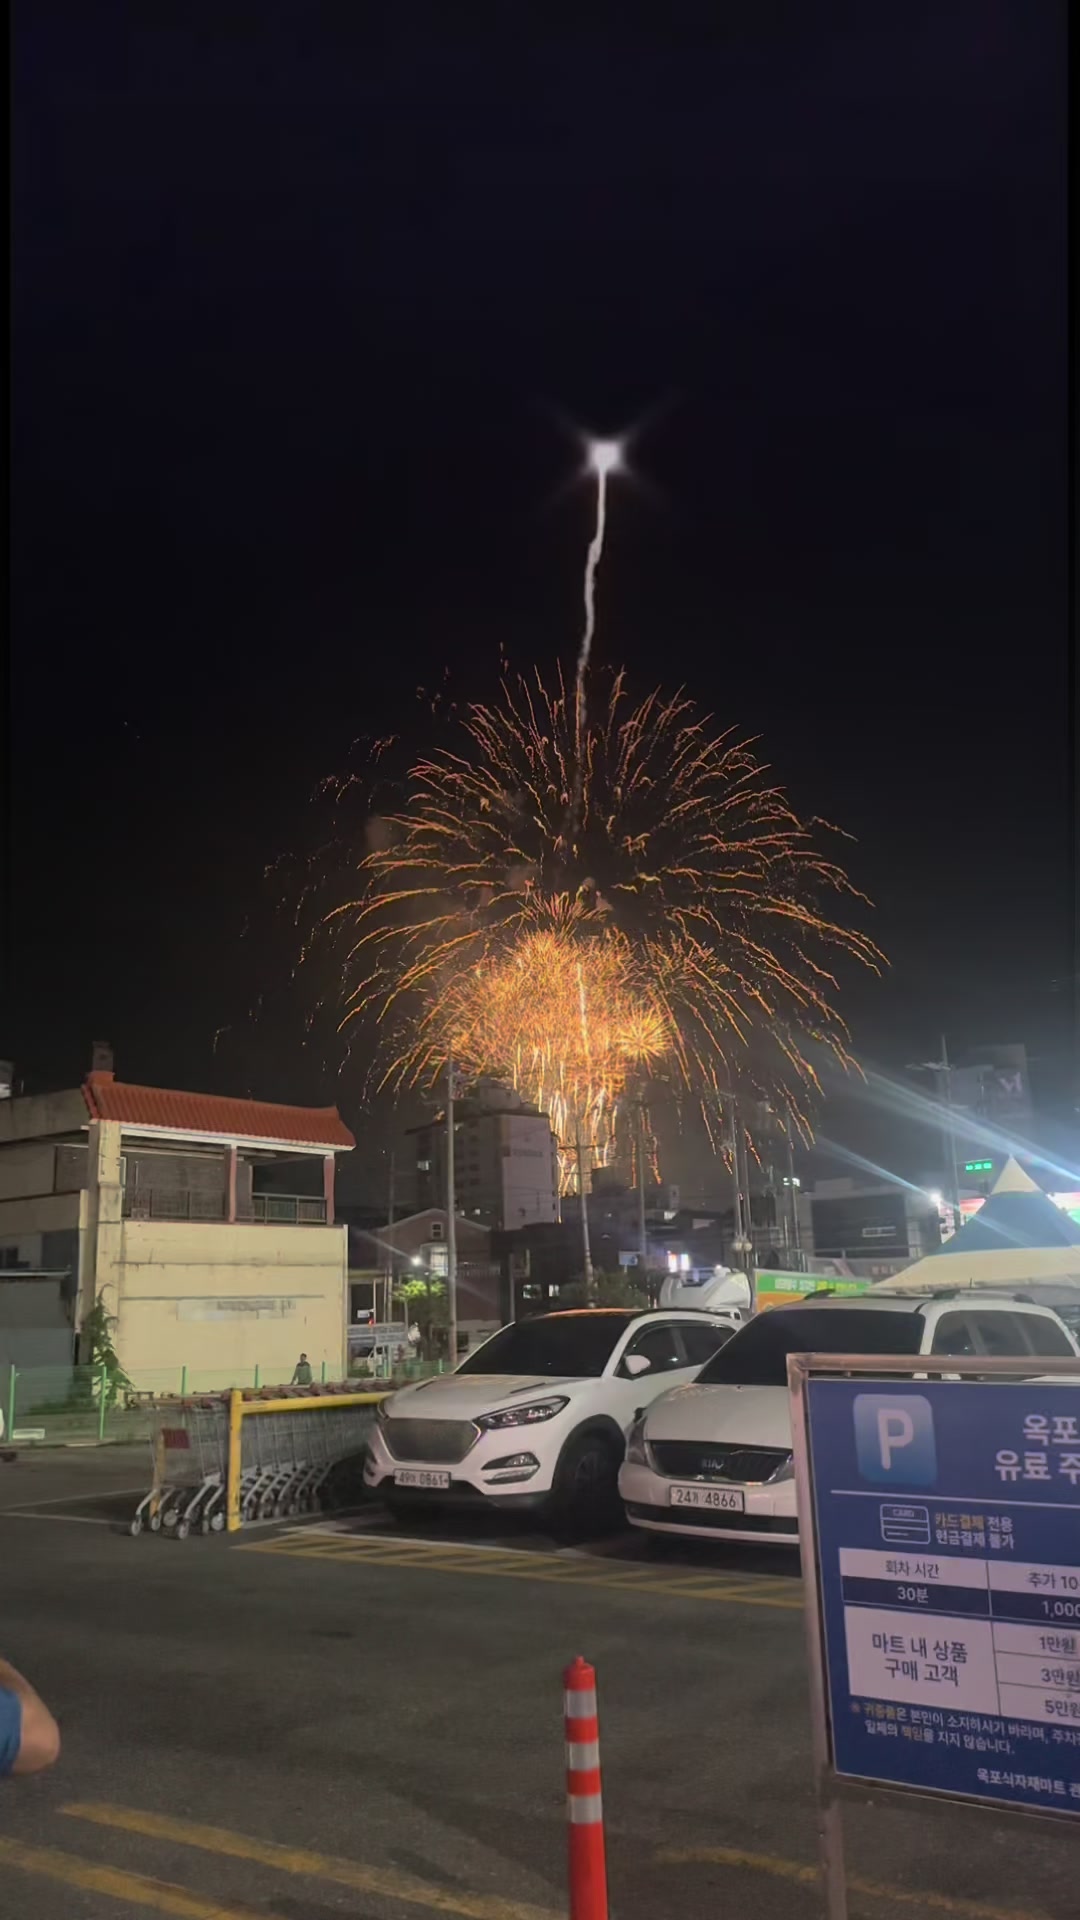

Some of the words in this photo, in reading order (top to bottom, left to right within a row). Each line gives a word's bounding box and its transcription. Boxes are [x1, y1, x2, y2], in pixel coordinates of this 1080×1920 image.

[878, 1408, 914, 1471] P
[1023, 1413, 1080, 1447] 옥포
[994, 1449, 1052, 1482] 유료
[704, 1491, 737, 1509] 4866
[987, 1516, 1014, 1533] 전용
[914, 1561, 940, 1580] 시간
[897, 1586, 929, 1604] 30분
[872, 1632, 906, 1654] 마트
[911, 1637, 928, 1659] 내
[933, 1640, 968, 1664] 상품
[884, 1657, 919, 1682] 구매
[924, 1663, 959, 1688] 고객
[947, 1715, 1005, 1737] 소지하시기
